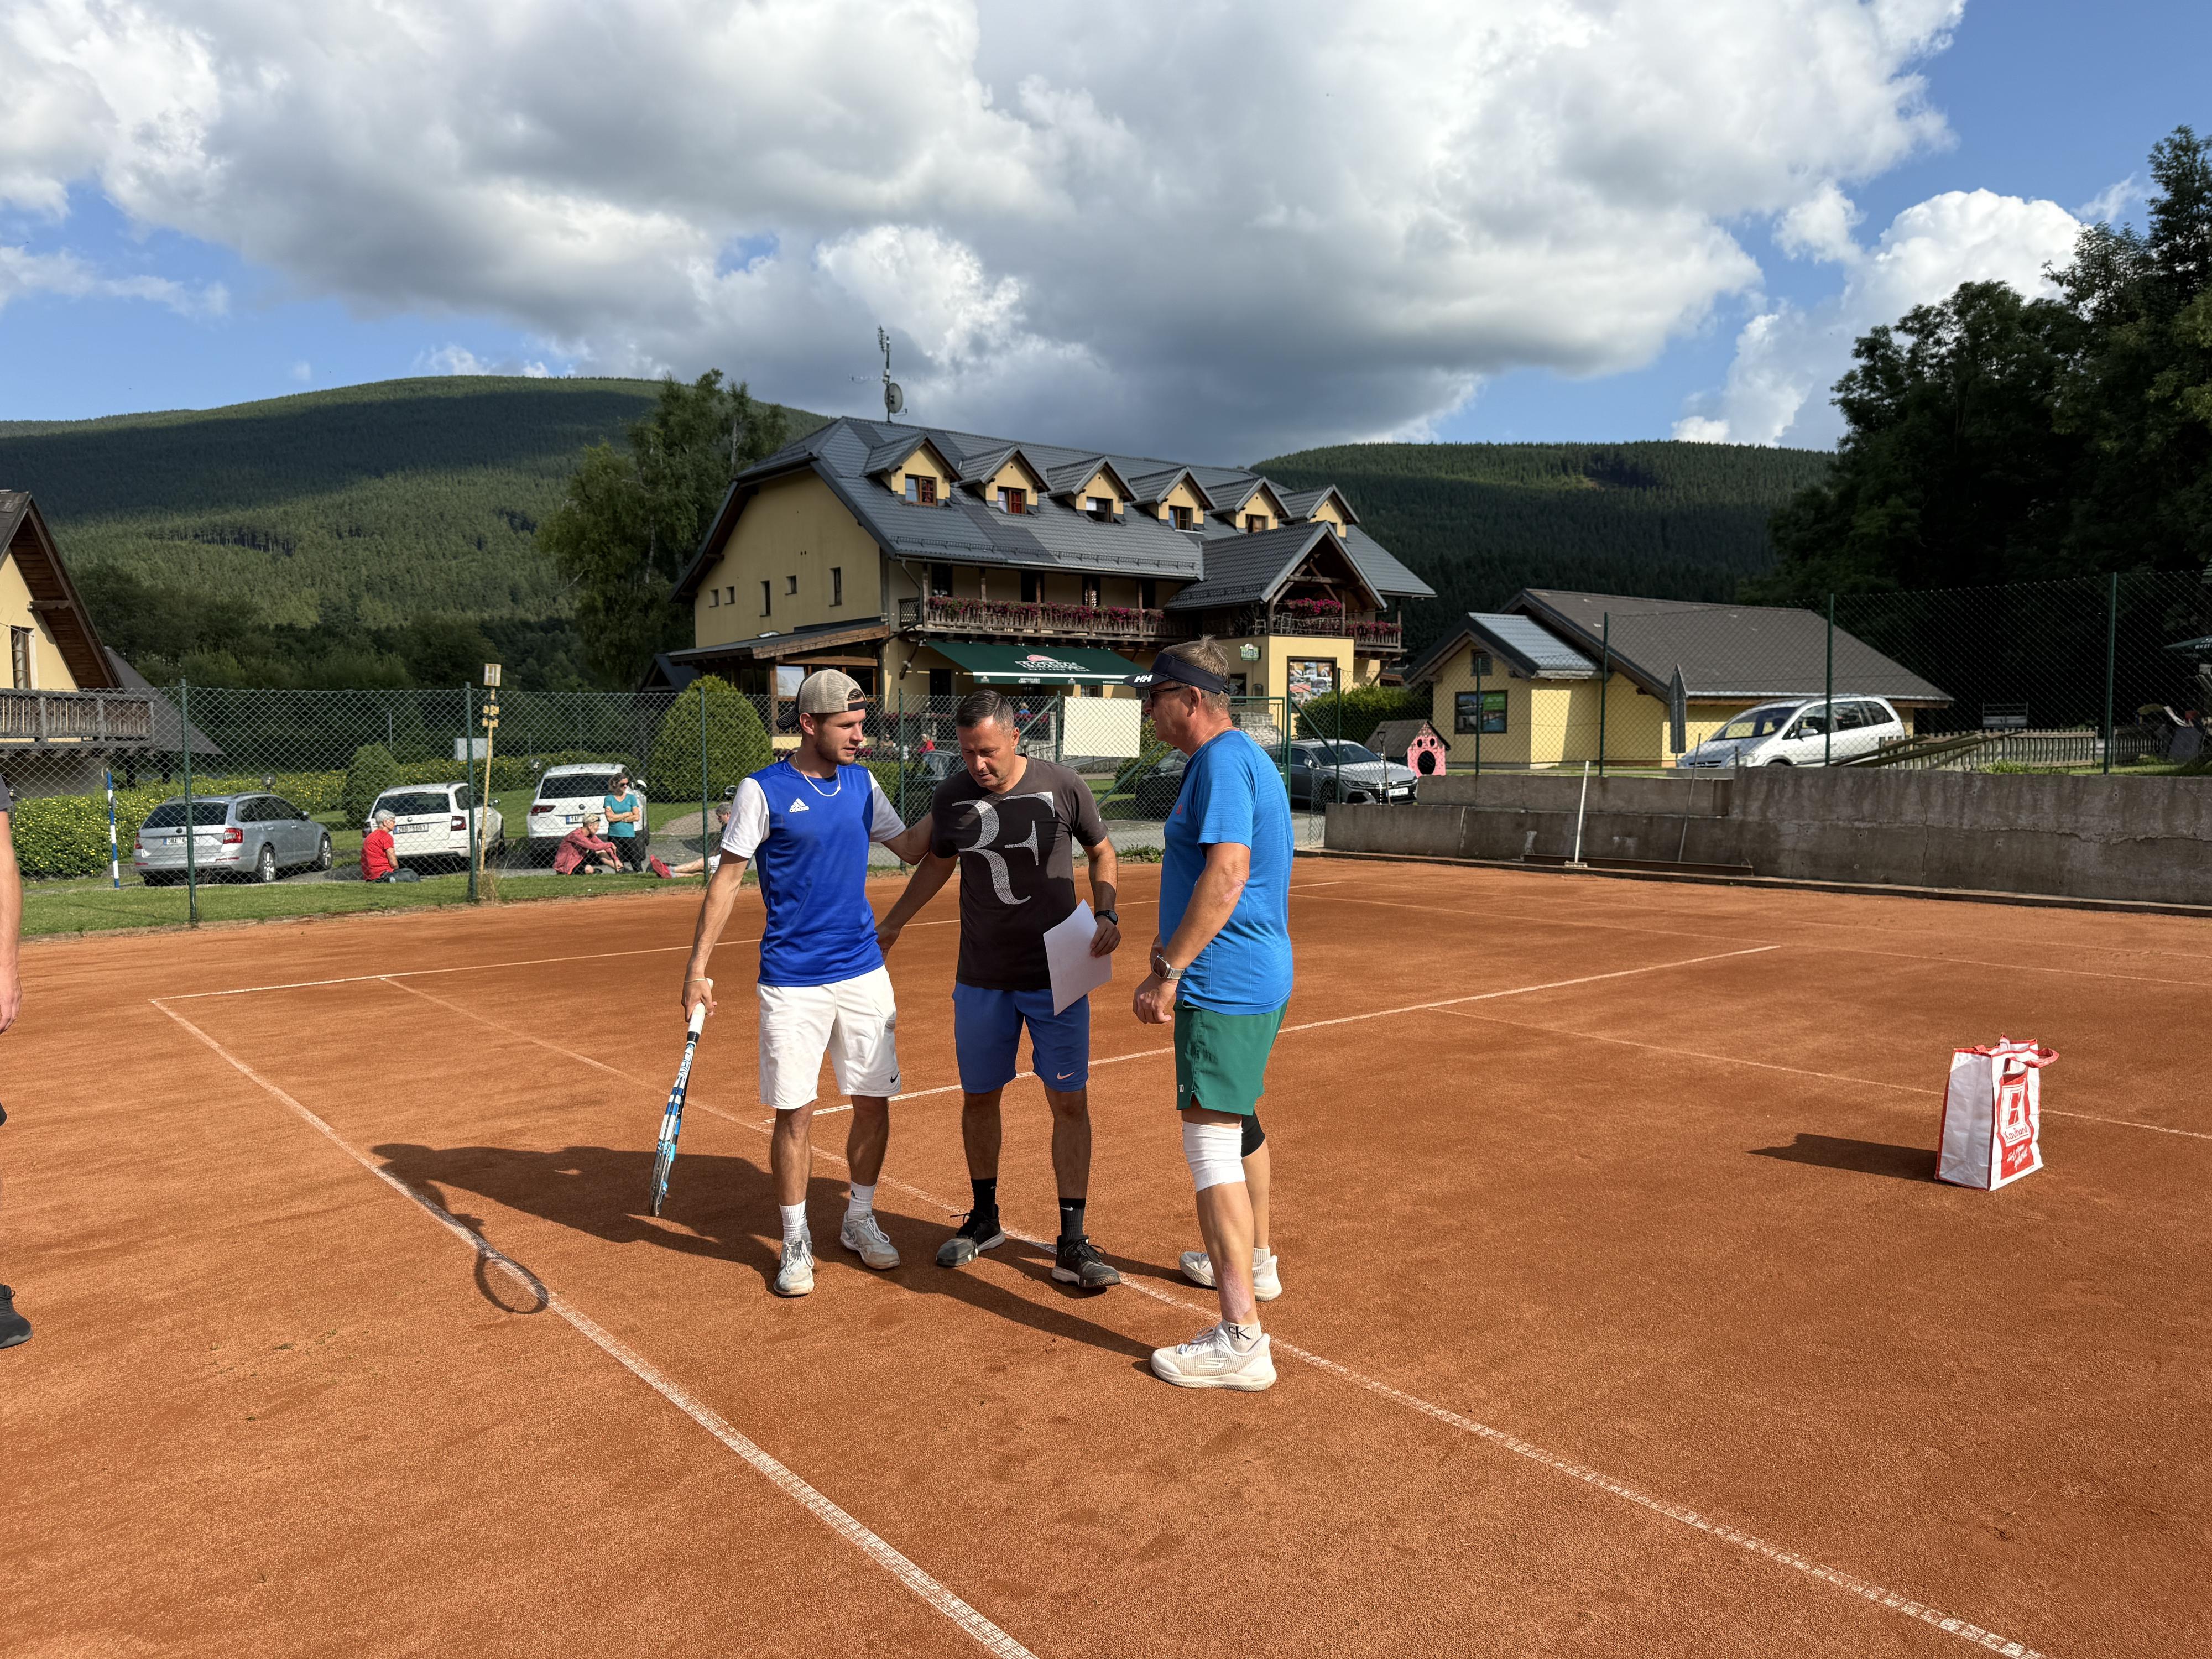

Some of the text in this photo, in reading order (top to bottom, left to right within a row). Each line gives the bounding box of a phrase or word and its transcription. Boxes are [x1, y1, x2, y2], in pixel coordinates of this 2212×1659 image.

[1134, 674, 1153, 683] HH
[952, 791, 1055, 905] RF
[2002, 1126, 2028, 1141] Kaufland
